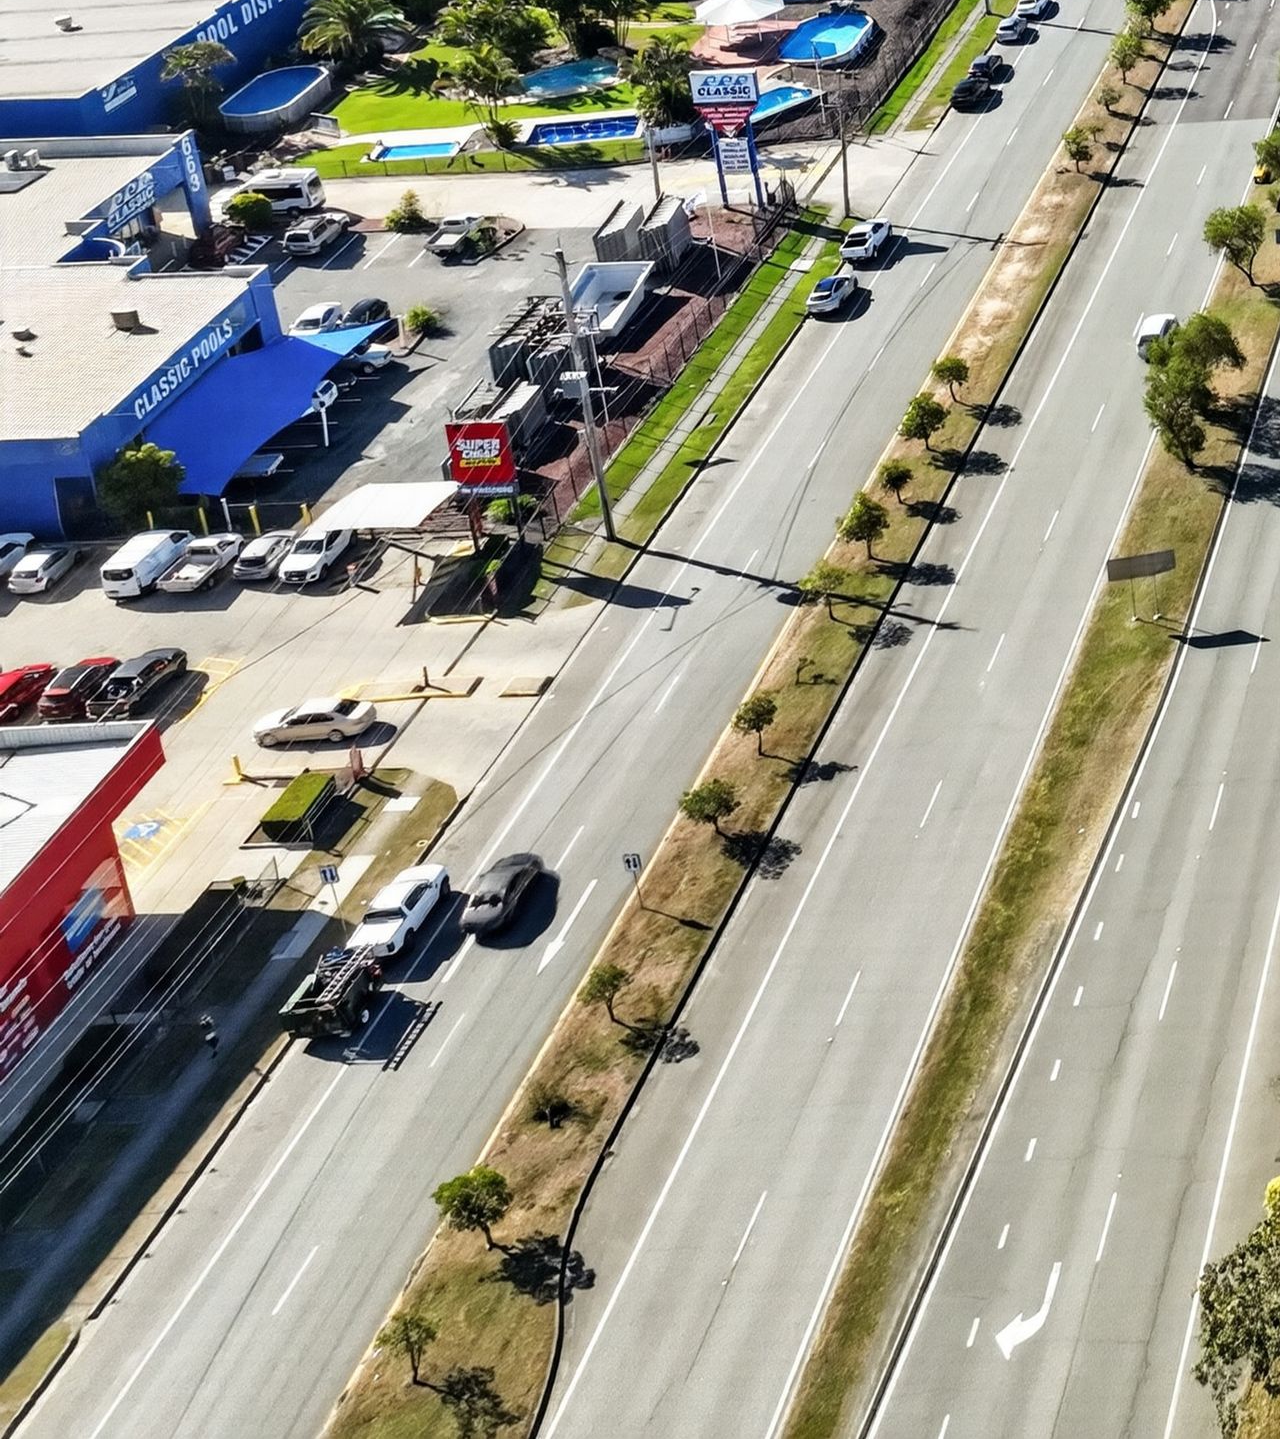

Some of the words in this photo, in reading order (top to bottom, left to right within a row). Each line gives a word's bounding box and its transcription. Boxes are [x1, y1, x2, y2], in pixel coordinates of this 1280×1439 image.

[697, 85, 751, 96] CLASSIC
[107, 184, 154, 228] CLASSIC
[134, 357, 191, 419] CLASSIC
[191, 318, 233, 368] POOLS
[456, 439, 500, 451] SUPER
